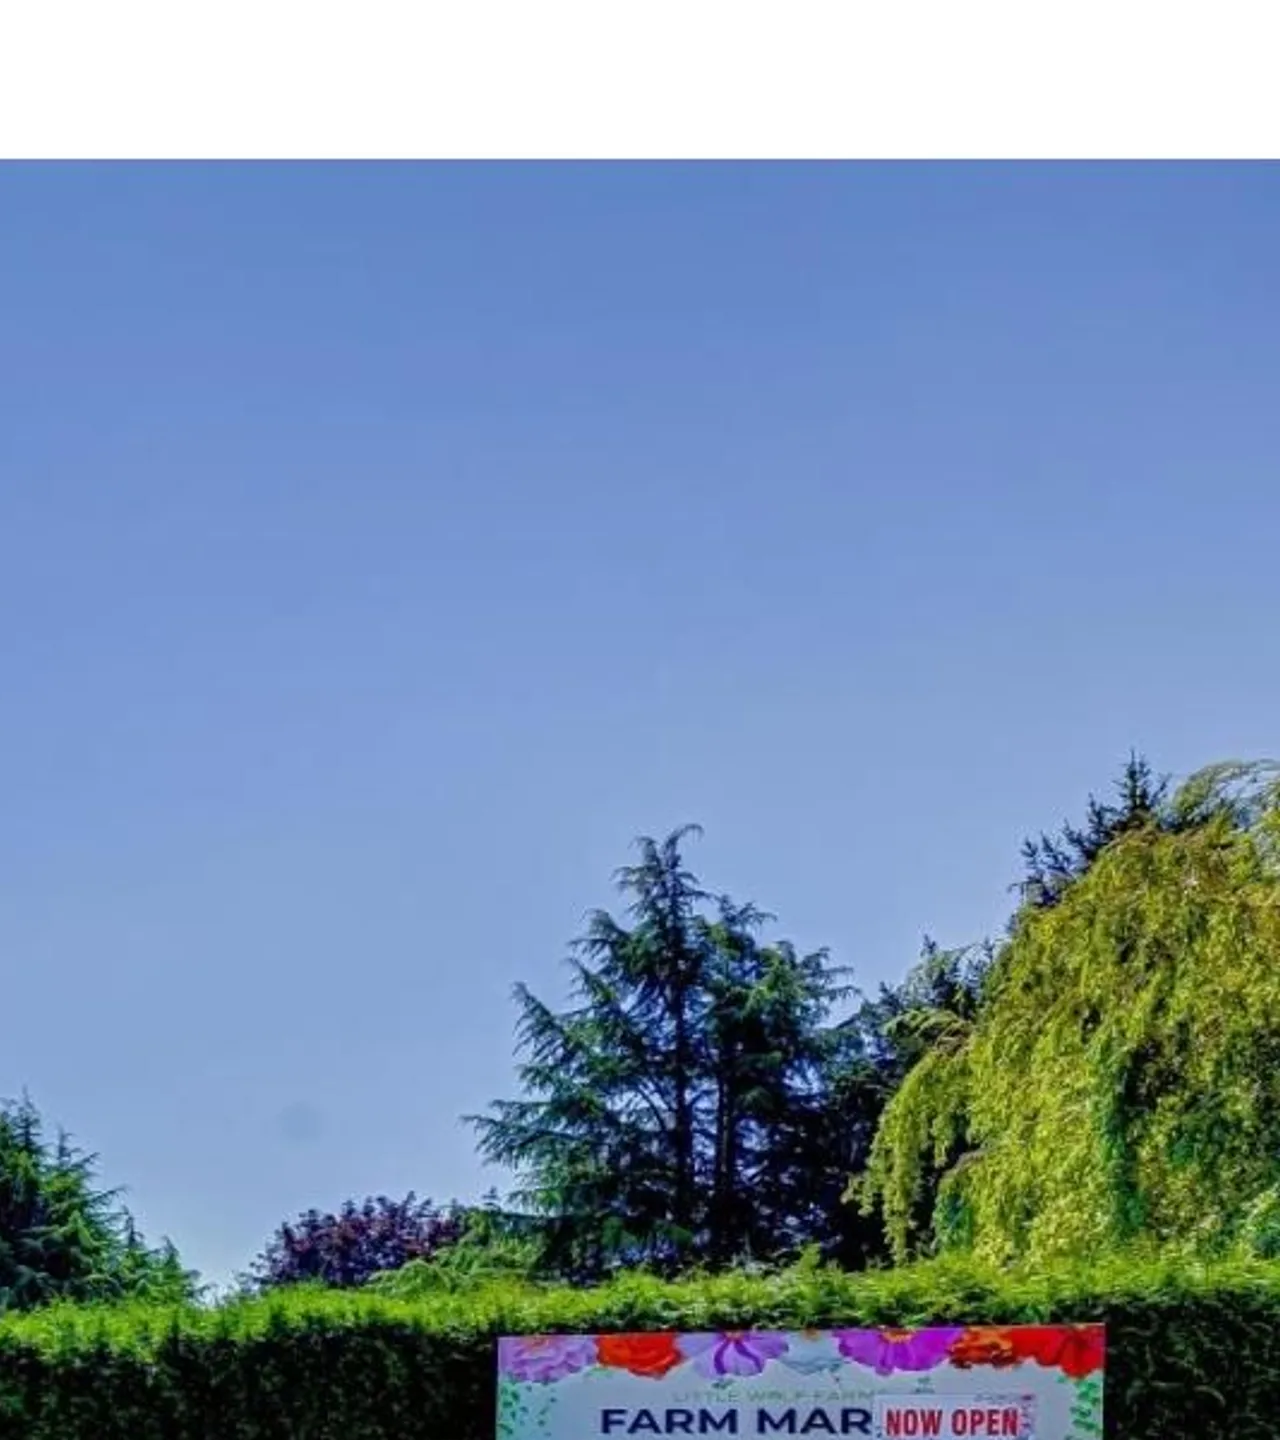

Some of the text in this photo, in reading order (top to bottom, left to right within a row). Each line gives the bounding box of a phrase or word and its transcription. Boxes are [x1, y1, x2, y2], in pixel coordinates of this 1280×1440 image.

[600, 1408, 874, 1435] FARM MAR
[886, 1408, 1019, 1437] NOW OPEN
